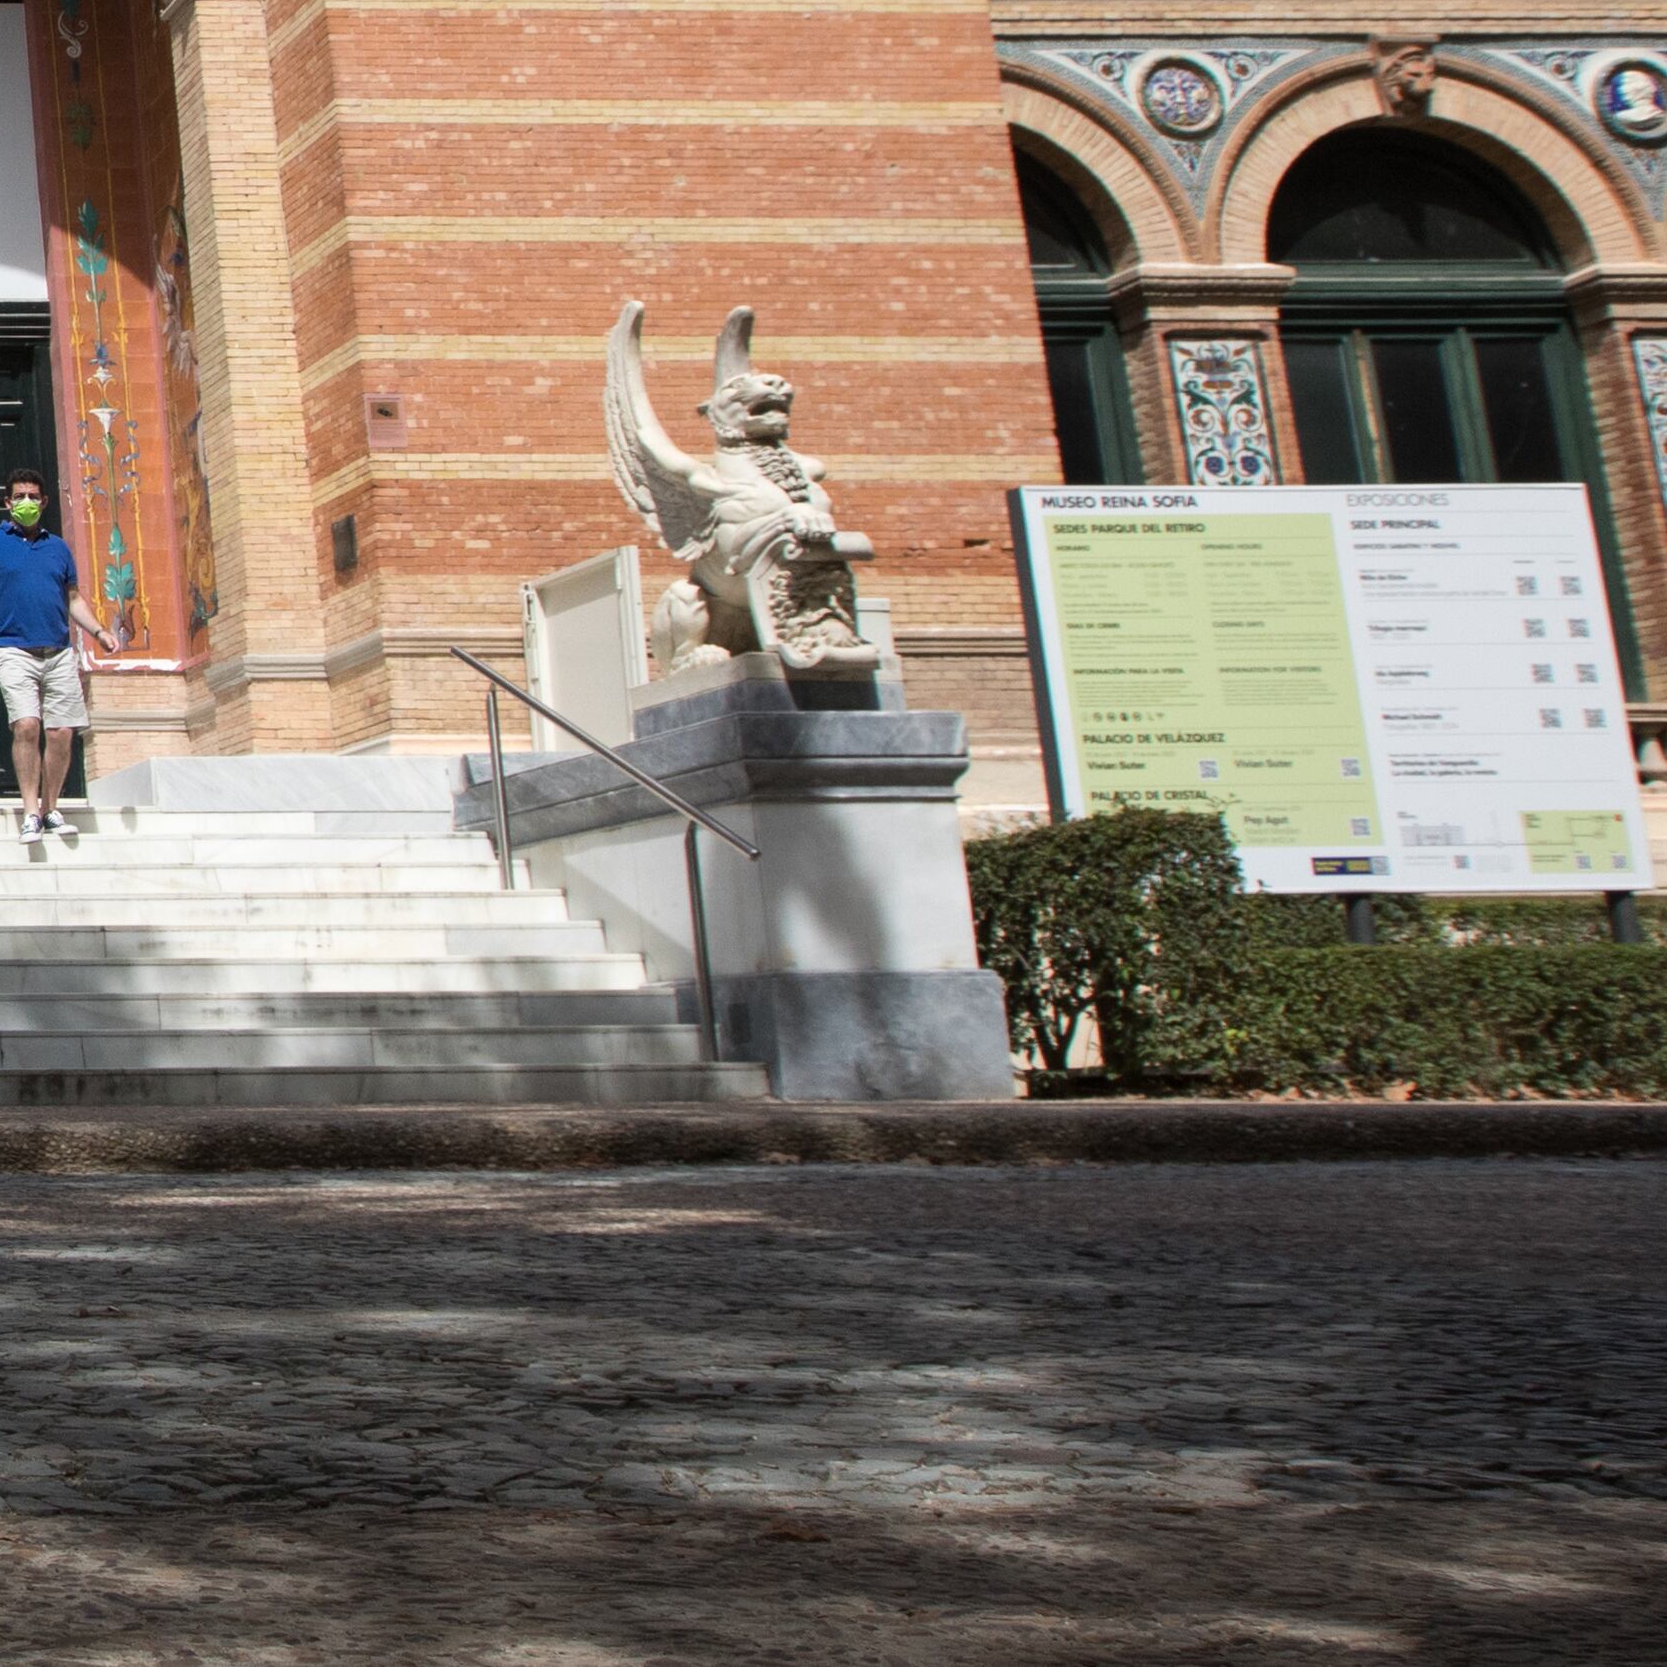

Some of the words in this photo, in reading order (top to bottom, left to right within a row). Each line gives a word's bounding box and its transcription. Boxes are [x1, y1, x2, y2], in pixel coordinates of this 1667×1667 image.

[1041, 497, 1097, 509] MUSEO
[1101, 496, 1148, 508] REINA
[1347, 494, 1450, 507] EXPOSICIONES
[1053, 524, 1088, 534] SEDES
[1091, 523, 1139, 534] PARQUE
[1142, 523, 1162, 533] DEL
[1165, 523, 1206, 533] RETIRO
[1351, 520, 1378, 530] SEDE
[1381, 519, 1441, 529] PRINCIPAL
[1082, 734, 1133, 744] PALACIO
[1137, 734, 1152, 744] DE
[1156, 731, 1225, 744] VELÁZQUEZ
[1091, 791, 1141, 801] PALACIO
[1145, 791, 1160, 801] DE
[1163, 790, 1208, 800] CRISTAL
